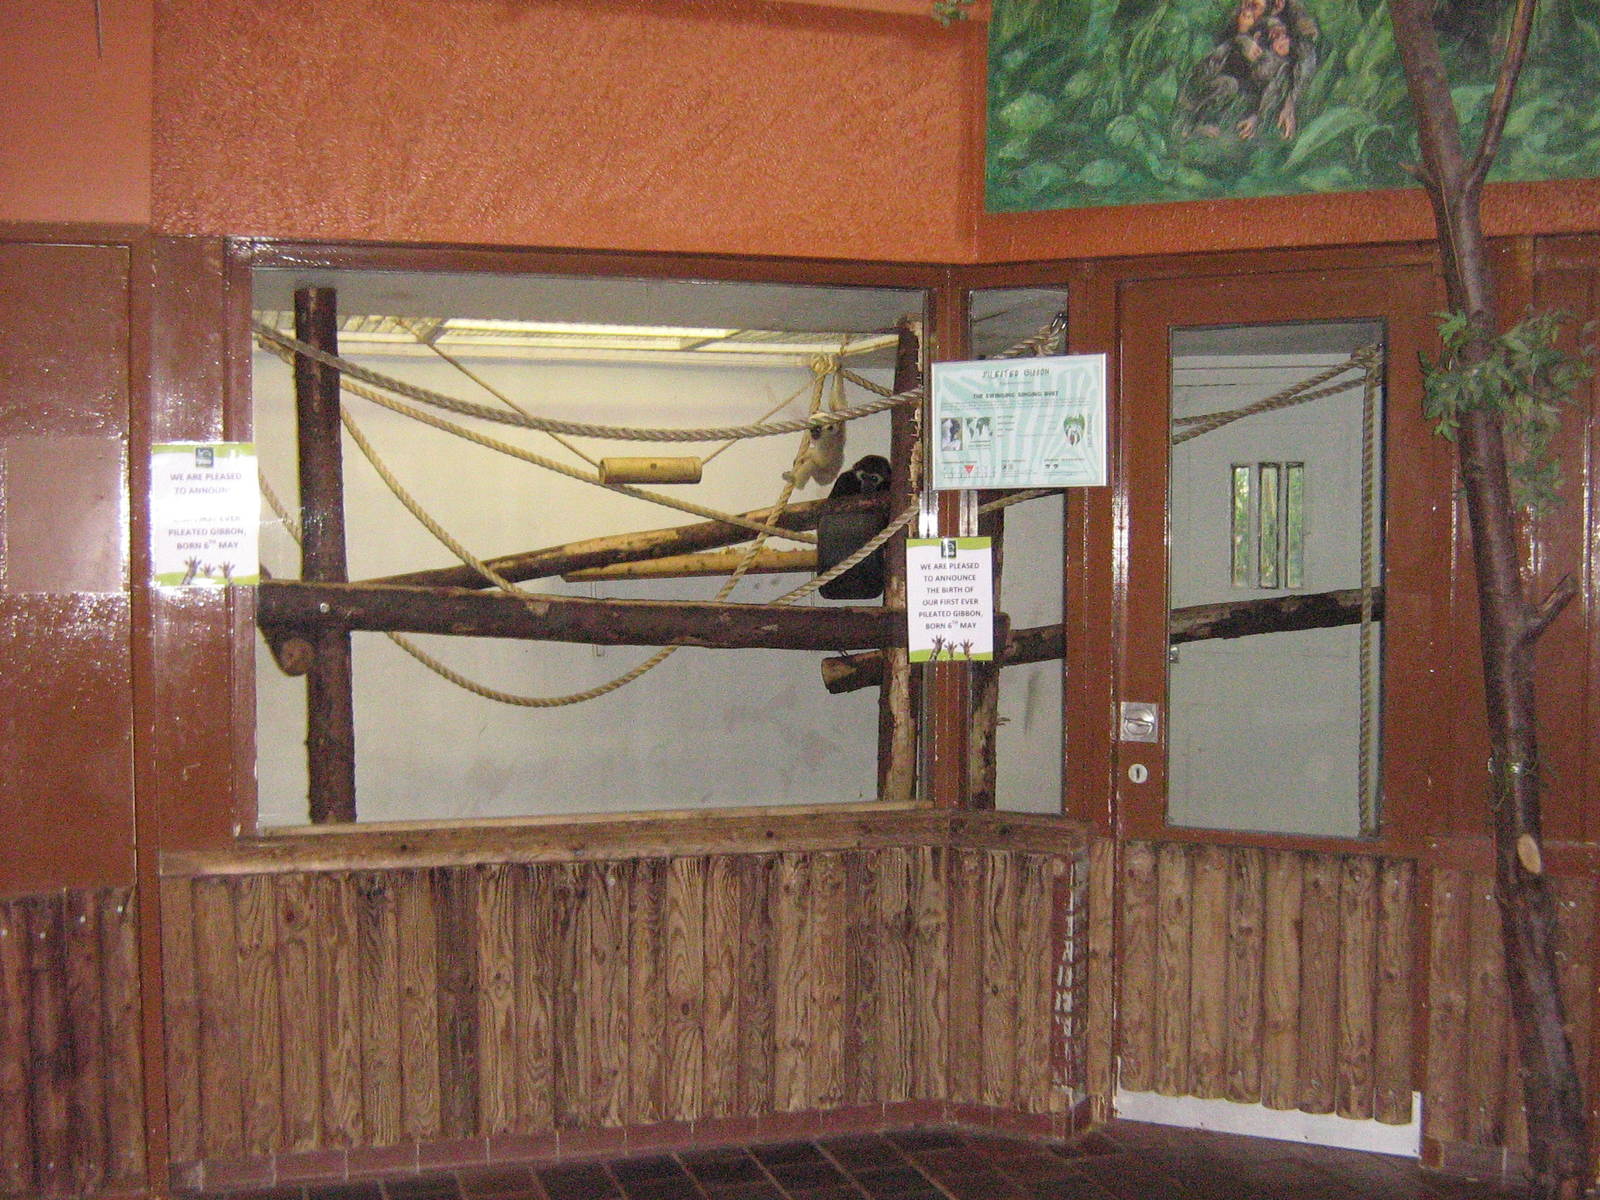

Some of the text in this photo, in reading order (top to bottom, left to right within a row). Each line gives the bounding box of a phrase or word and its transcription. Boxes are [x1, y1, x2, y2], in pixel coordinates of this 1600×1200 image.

[170, 472, 242, 481] WE ARE PLEASED
[174, 486, 187, 496] TO
[168, 527, 208, 537] PILEATED
[176, 541, 202, 550] BORN
[218, 541, 240, 550] MAY
[920, 563, 932, 571] WE
[949, 562, 980, 570] PLEASED
[935, 574, 976, 582] ANNOUNCE
[941, 586, 963, 594] BIRTH
[940, 598, 959, 606] FIRST
[918, 610, 951, 618] PILEATED
[925, 622, 946, 630] BORN
